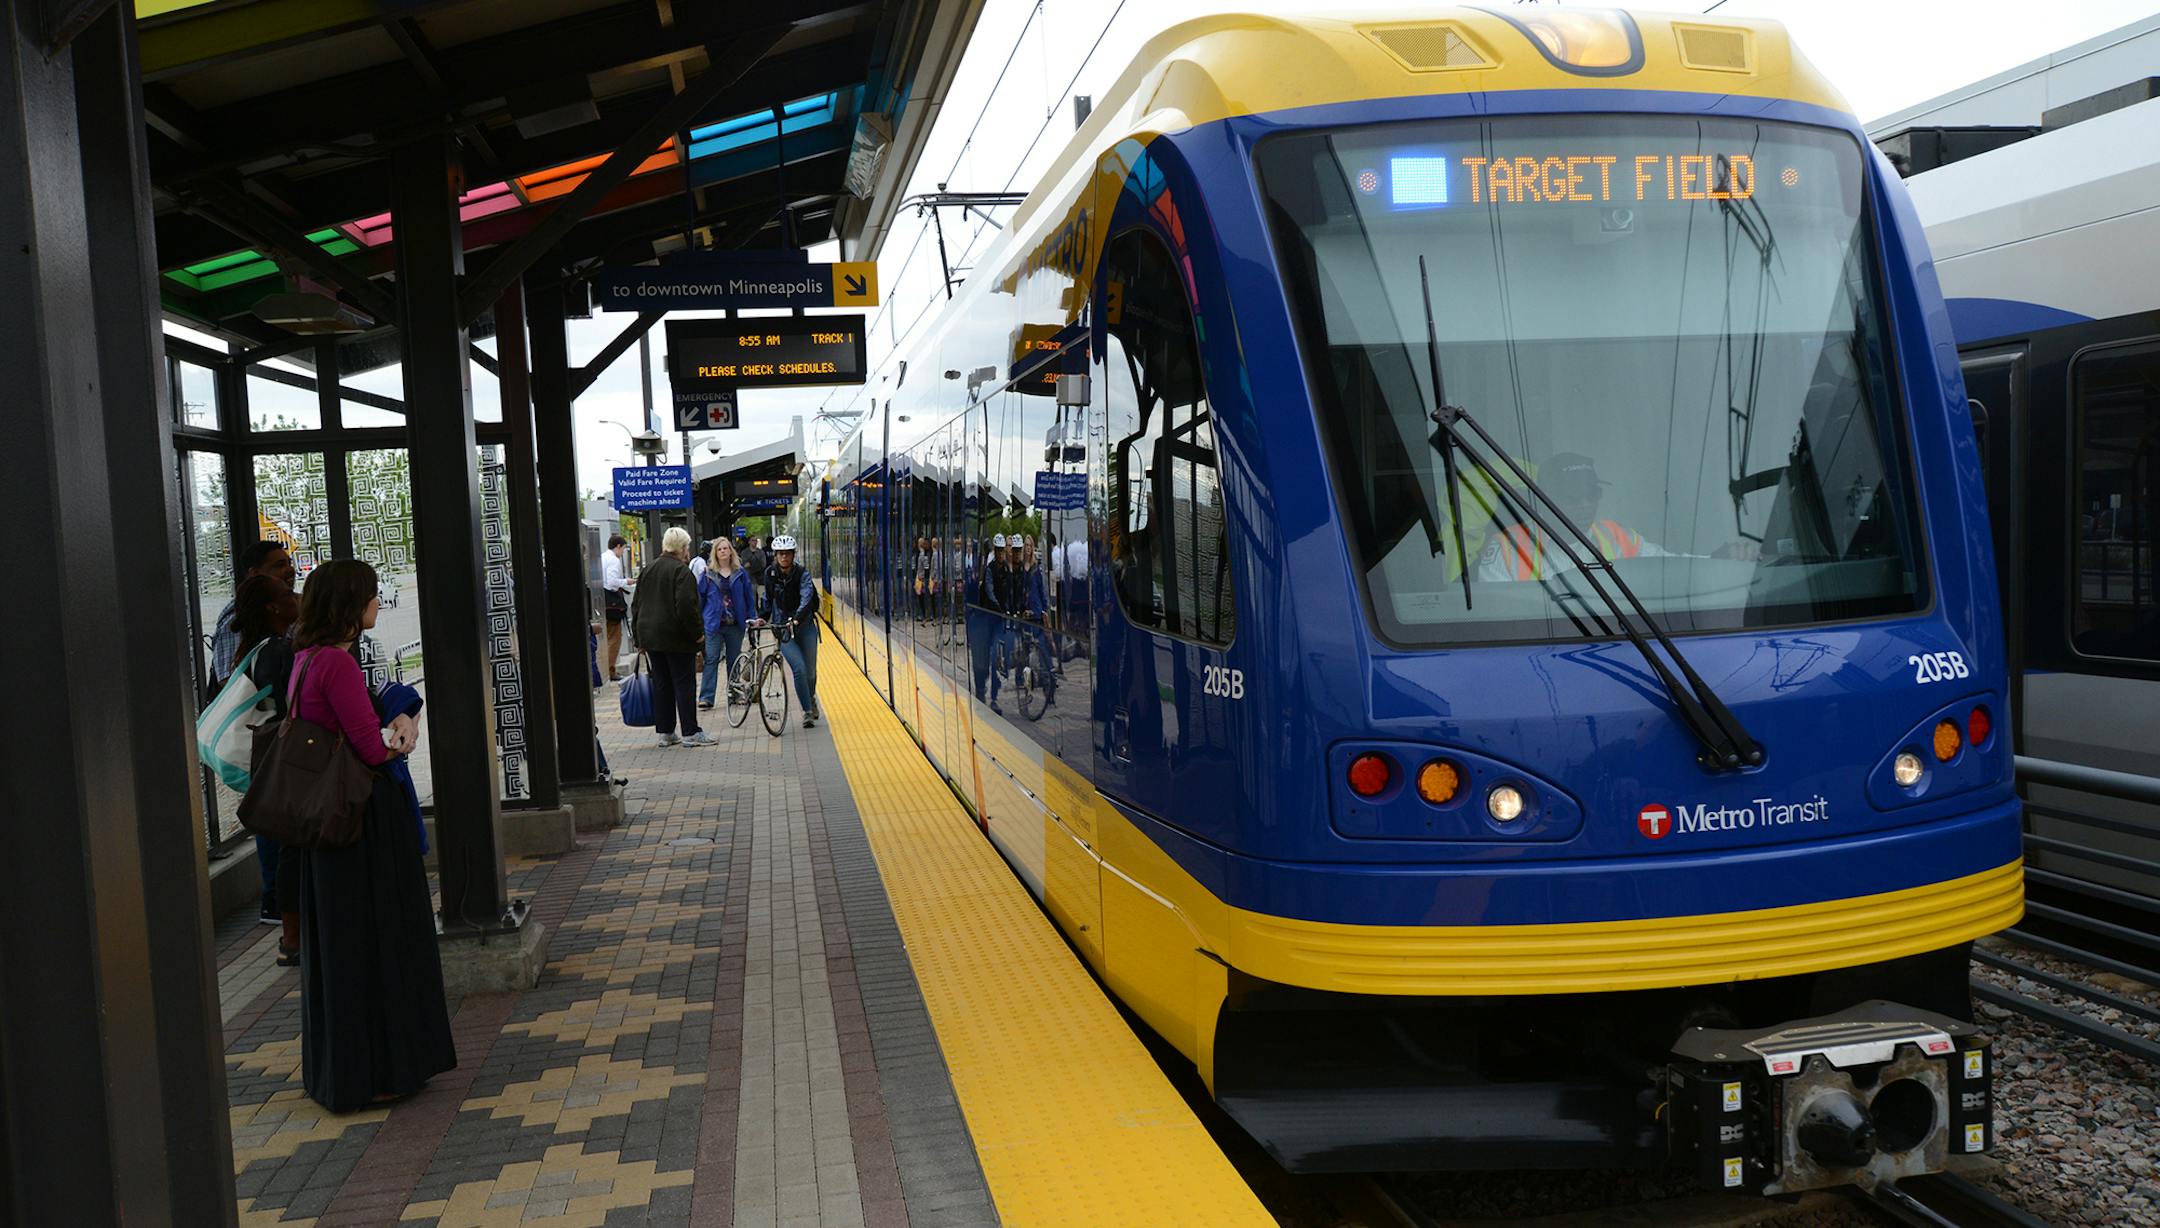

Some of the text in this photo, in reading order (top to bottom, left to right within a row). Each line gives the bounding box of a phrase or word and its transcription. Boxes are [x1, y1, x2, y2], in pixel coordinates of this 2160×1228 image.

[1462, 155, 1755, 203] TARGET FIELD
[612, 278, 824, 298] to downtown Minneapolis
[739, 335, 761, 346] 8:55
[766, 335, 780, 346] AM
[812, 333, 844, 345] TRACK
[698, 362, 837, 377] PLEASE CHECK SCHEDULES.
[676, 391, 734, 402] EMERGENCY
[625, 470, 641, 478] Paid
[642, 469, 658, 477] Fare
[618, 479, 636, 487] Valid
[655, 477, 687, 486] Required
[622, 489, 652, 498] Proceed
[664, 488, 684, 496] ticket
[627, 497, 680, 506] machine ahead
[1909, 650, 1970, 685] 205B
[1203, 664, 1244, 700] 205B
